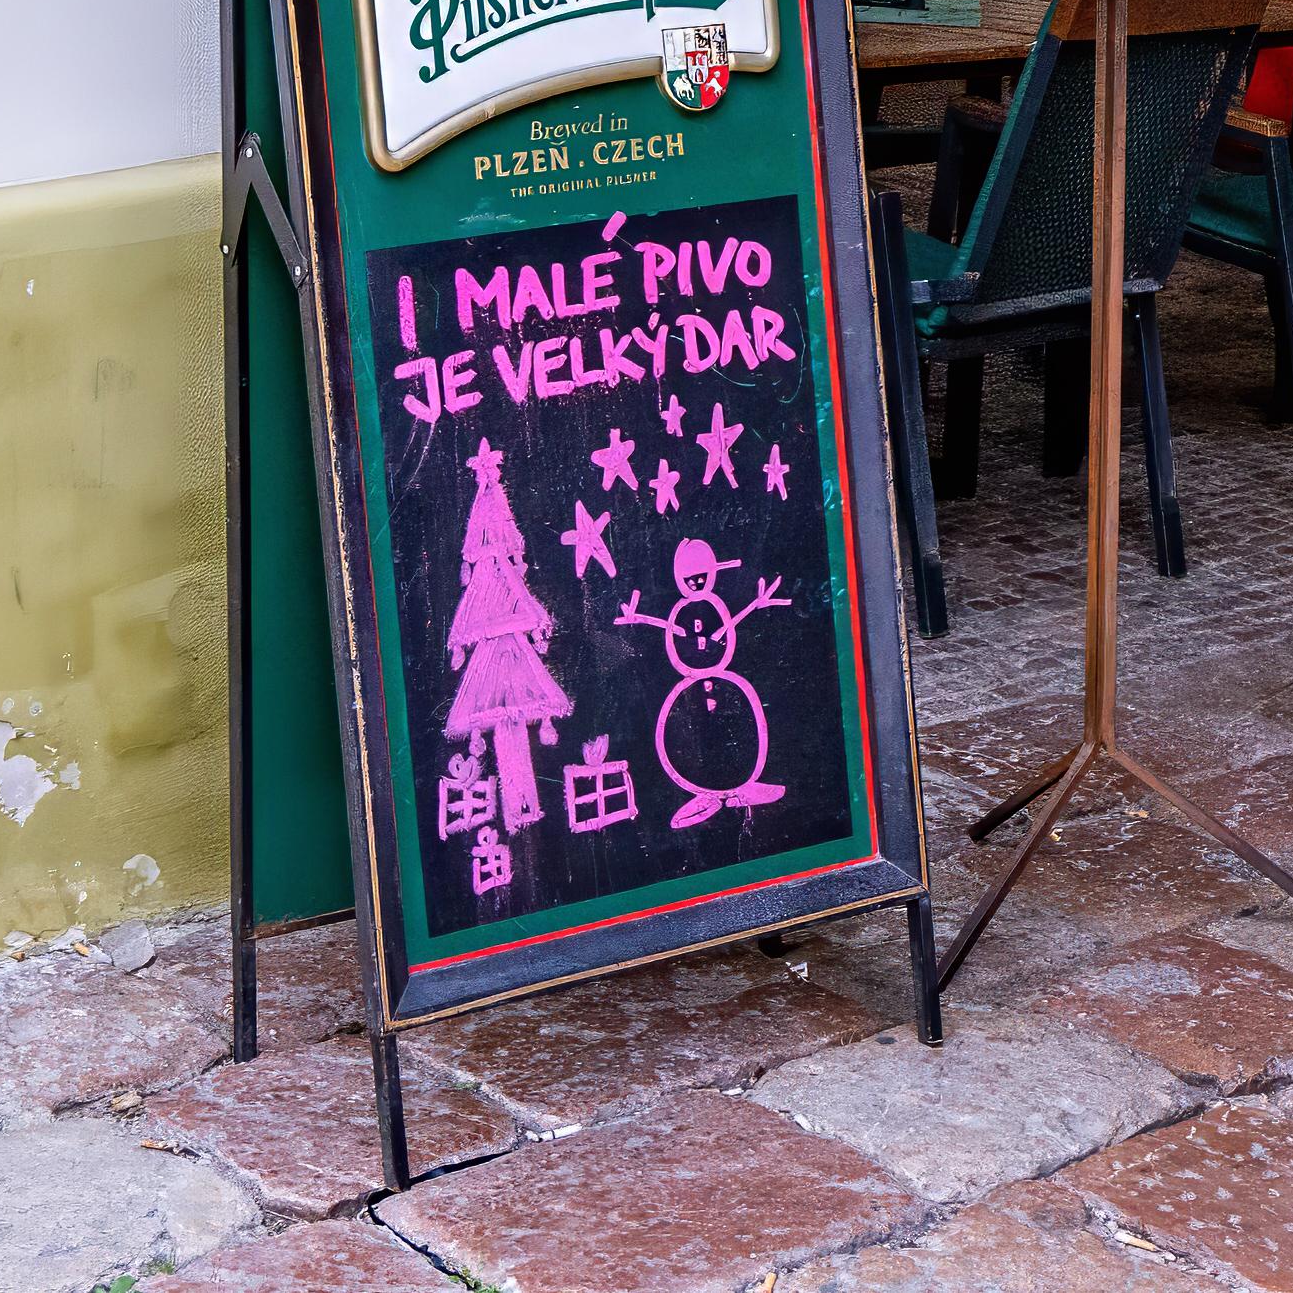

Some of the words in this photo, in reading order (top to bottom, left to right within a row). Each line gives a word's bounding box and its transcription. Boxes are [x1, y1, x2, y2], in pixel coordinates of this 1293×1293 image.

[530, 113, 604, 141] Brewed
[609, 112, 628, 132] in
[473, 139, 570, 181] PLZEŇ
[592, 132, 685, 166] CZECH
[510, 185, 534, 199] THE
[538, 176, 603, 196] ORIGINAL
[606, 170, 657, 187] PILSNER
[397, 275, 418, 352] I
[454, 210, 627, 332] MALÉ
[633, 236, 772, 305] PIVO
[394, 349, 484, 424] JE
[492, 311, 669, 404] VELKÝ
[674, 305, 797, 375] DAR
